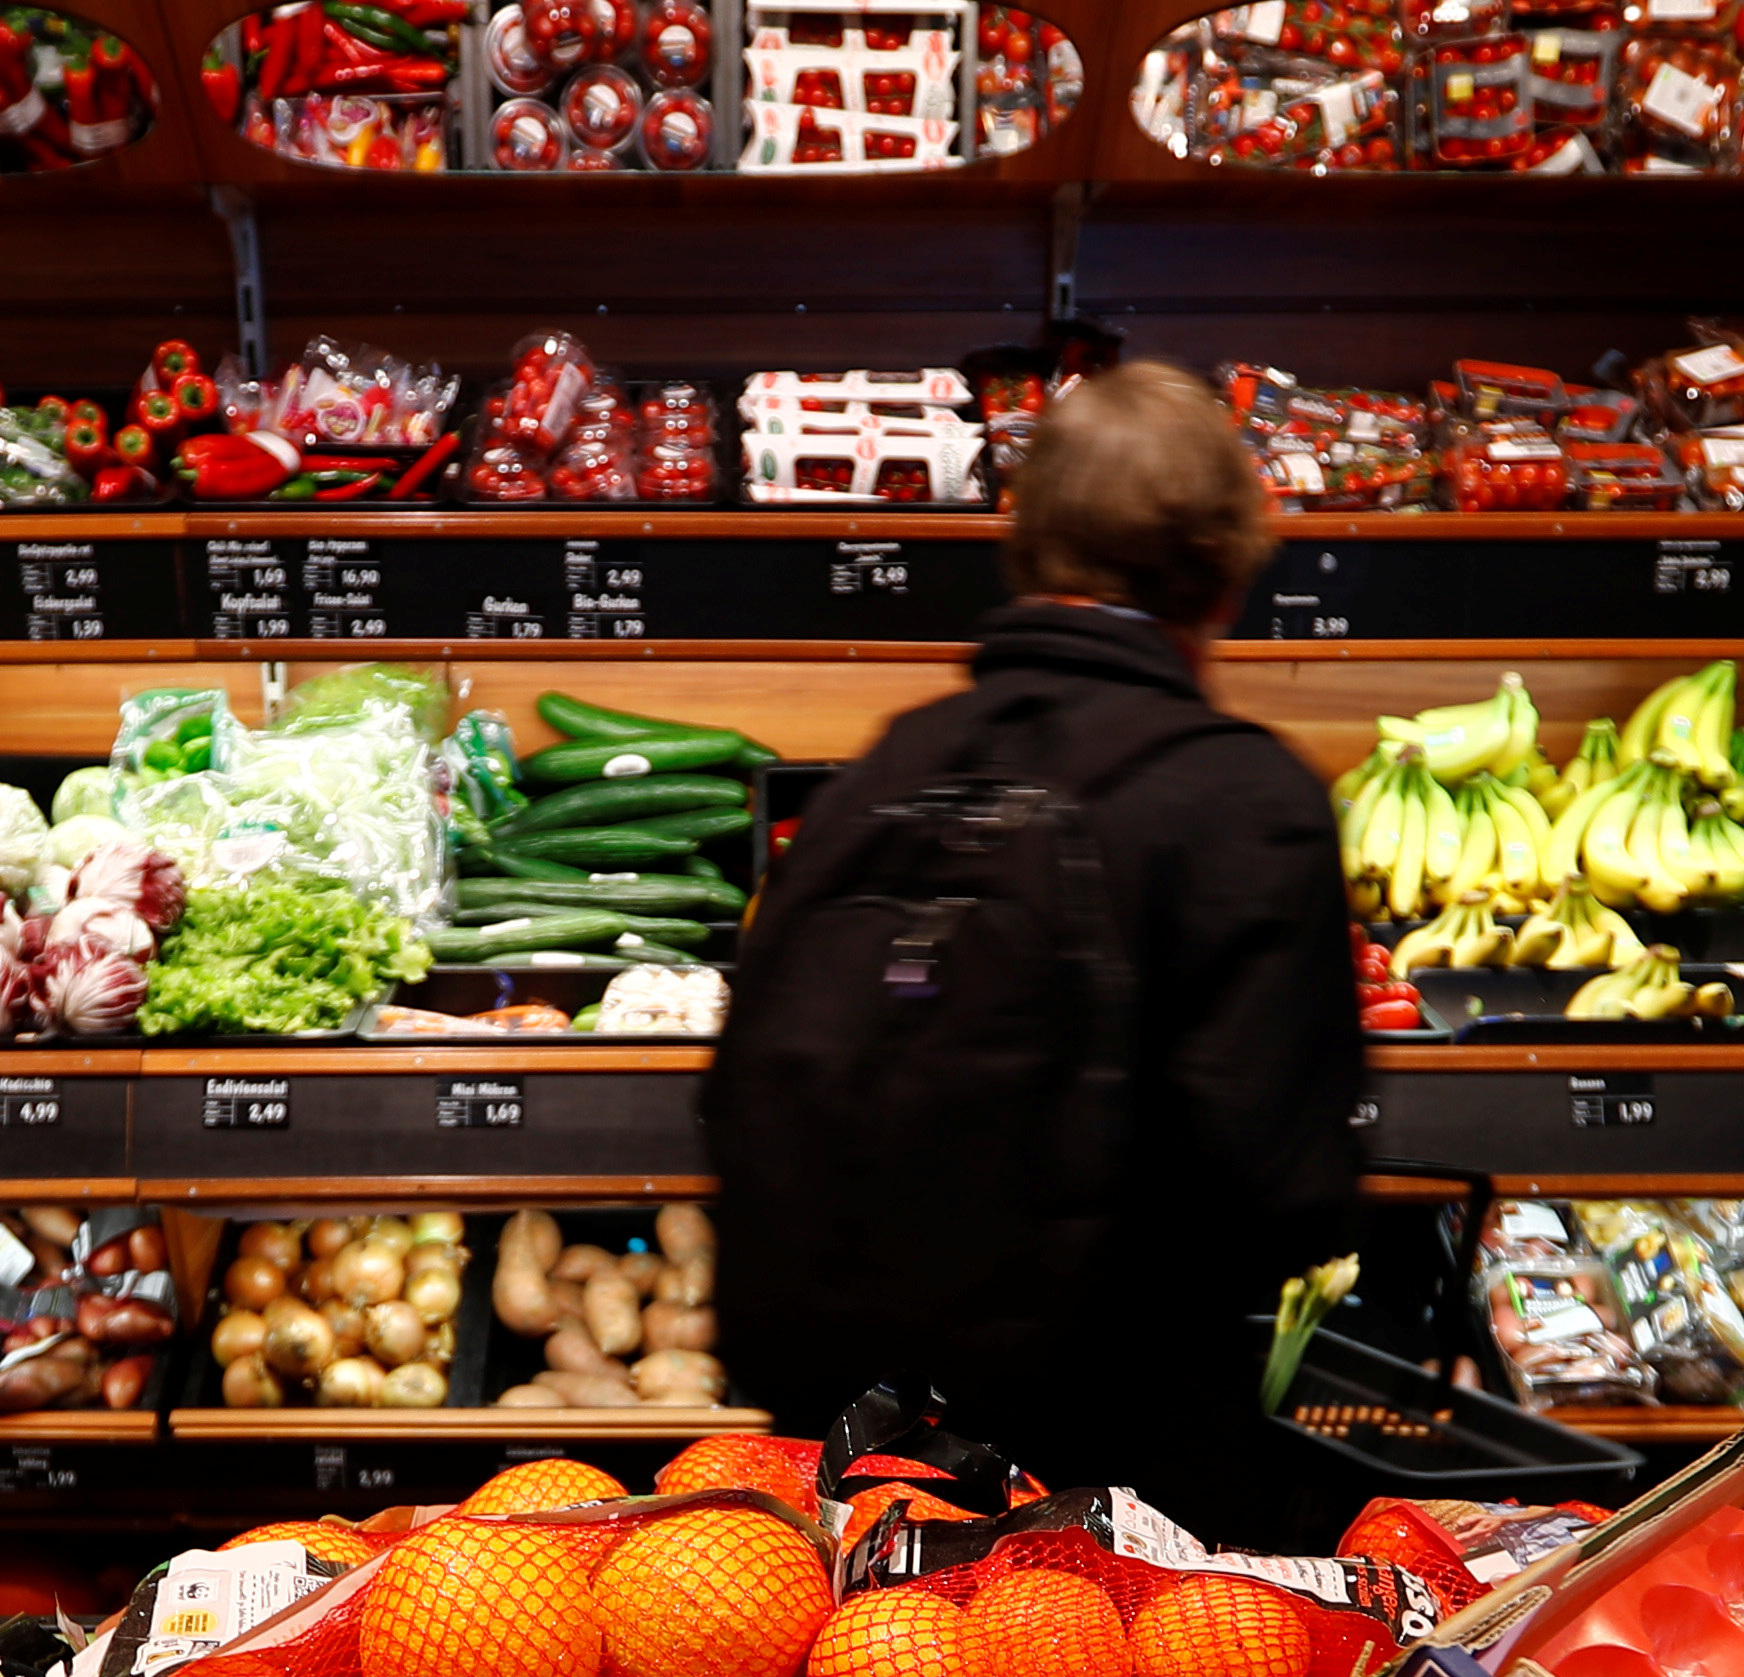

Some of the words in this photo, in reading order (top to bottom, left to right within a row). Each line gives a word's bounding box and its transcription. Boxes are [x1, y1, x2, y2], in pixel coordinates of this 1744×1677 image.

[254, 568, 287, 587] 1,69
[341, 569, 379, 587] 16,90
[606, 569, 643, 586] 2,49
[33, 596, 96, 612] Eisbergsalat
[221, 594, 282, 613] Kopfsalat
[482, 597, 530, 614] Gurken
[572, 593, 641, 610] Bio-Gurken
[72, 619, 104, 637] 1,39
[257, 618, 290, 637] 1,99
[350, 619, 387, 637] 2,49
[512, 622, 543, 639] 1,79
[613, 619, 645, 637] 1,79
[206, 1077, 289, 1097] Endiviensalat
[451, 1081, 474, 1096] Mini
[478, 1080, 518, 1096] Möhren
[19, 1101, 60, 1124] 4,99
[248, 1103, 288, 1123] 2,49
[484, 1102, 522, 1124] 1,69
[1617, 1101, 1653, 1124] 1,99
[359, 1469, 394, 1487] 2,99
